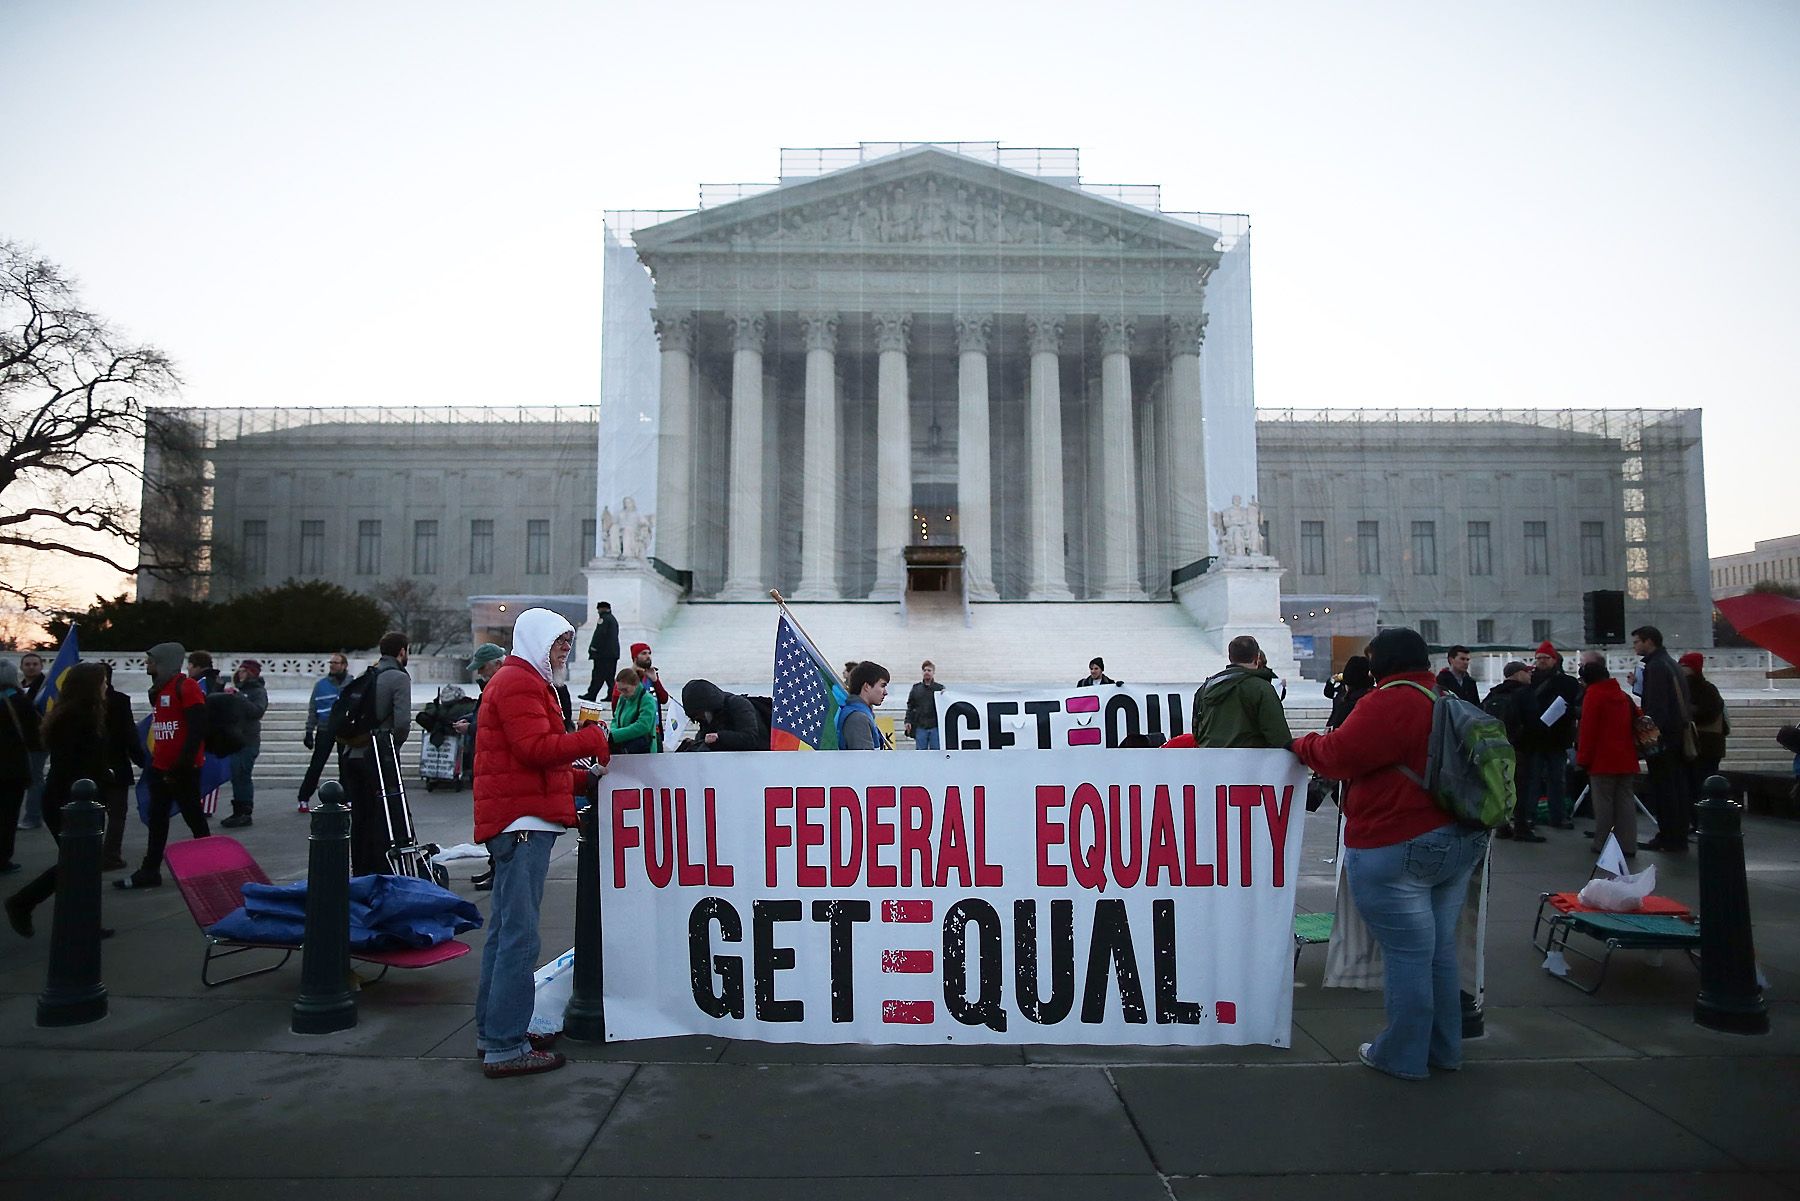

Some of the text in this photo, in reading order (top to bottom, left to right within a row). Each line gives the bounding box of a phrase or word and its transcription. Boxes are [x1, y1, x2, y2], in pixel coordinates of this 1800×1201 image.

[611, 782, 1294, 893] FULL FEDERAL EQUALITY
